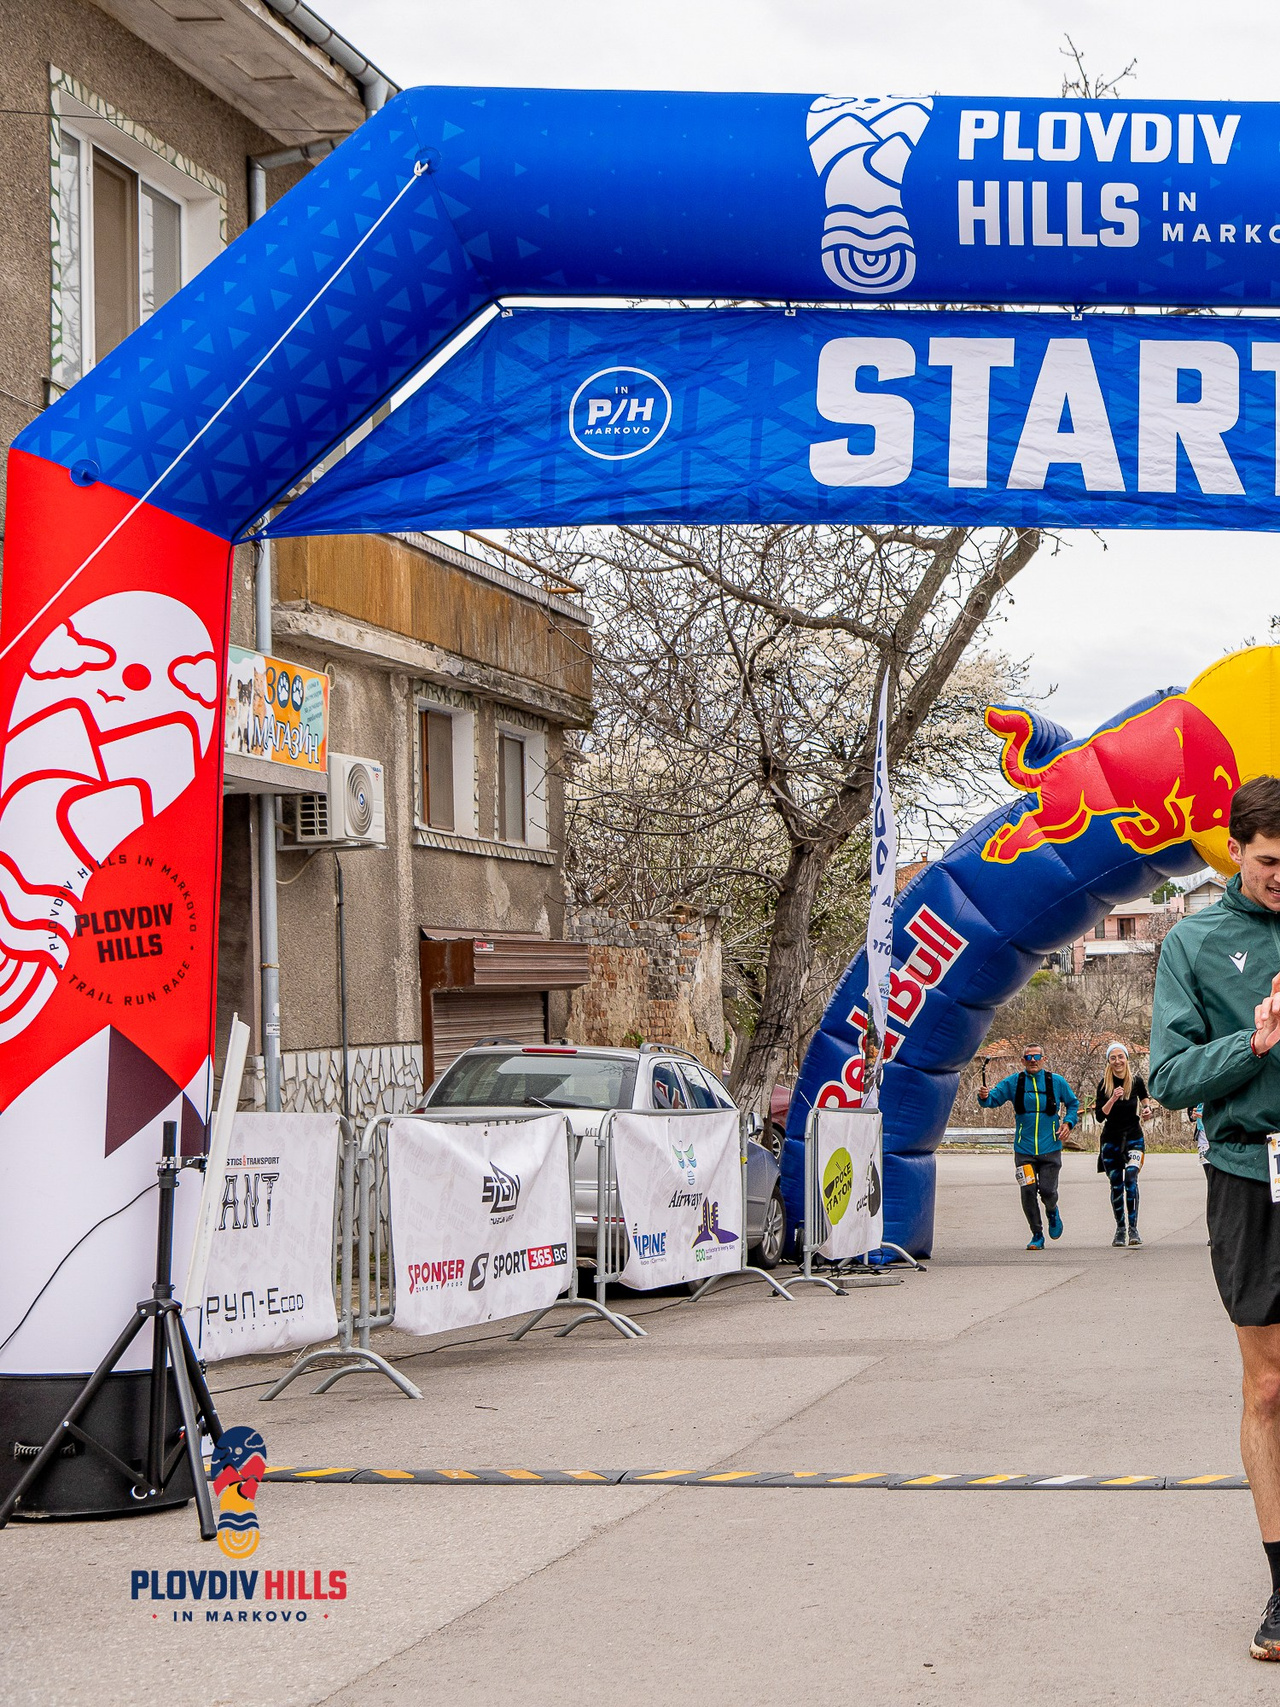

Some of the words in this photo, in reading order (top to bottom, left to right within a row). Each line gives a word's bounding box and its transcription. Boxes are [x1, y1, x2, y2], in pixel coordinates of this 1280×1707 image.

[958, 110, 1241, 164] PLOVDIV
[958, 180, 1139, 247] HILLS
[1162, 192, 1197, 212] IN
[615, 386, 629, 395] IN
[584, 426, 651, 436] MARKOVO
[253, 714, 319, 764] МАГАЗИН
[48, 880, 73, 951] PLOVDIV
[77, 854, 127, 879] HILLS
[137, 854, 154, 867] IN
[161, 864, 197, 932] MARKOVO
[74, 903, 173, 937] PLOVDIV
[97, 933, 163, 963] HILLS
[886, 905, 966, 1026] Bull
[68, 974, 113, 1004] TRAIL
[124, 992, 157, 1006] RUN
[162, 960, 190, 995] RACE
[246, 1156, 280, 1166] TRANSPORT
[835, 1162, 851, 1188] POKE
[408, 1259, 464, 1294] SPONSER
